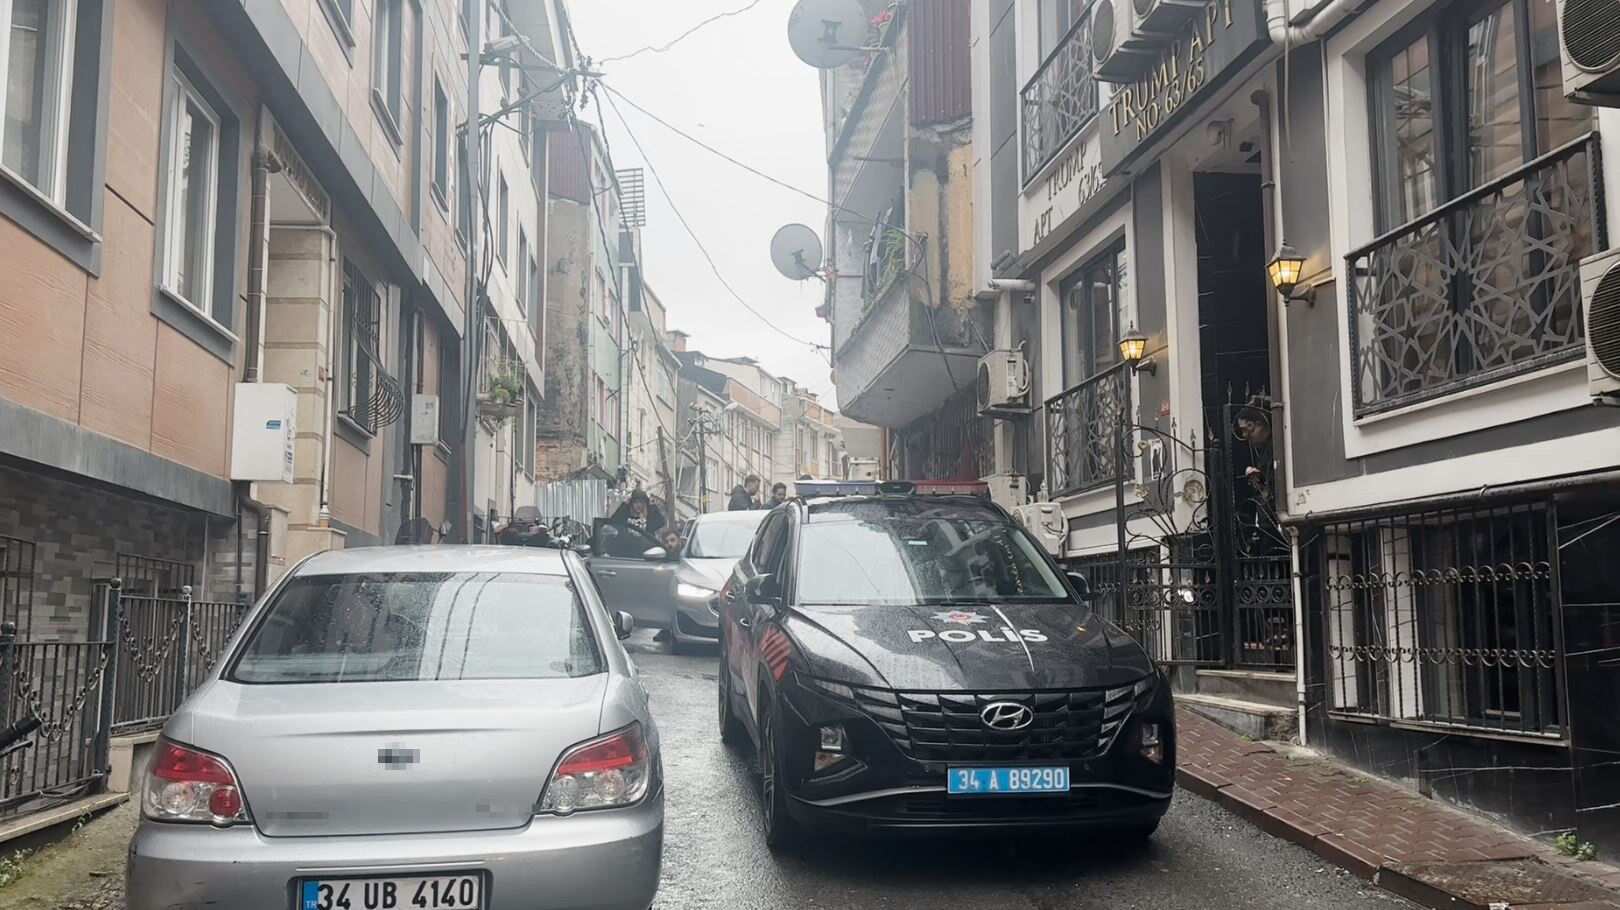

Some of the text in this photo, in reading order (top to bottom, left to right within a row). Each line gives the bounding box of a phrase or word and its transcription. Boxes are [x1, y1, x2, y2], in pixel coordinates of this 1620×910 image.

[1108, 40, 1181, 136] TRUMP
[1136, 54, 1205, 142] NO: 63/65
[1045, 142, 1088, 201] TRUMP
[1033, 205, 1054, 245] APT
[958, 767, 1065, 790] 34 A 89290
[305, 900, 317, 909] TR
[317, 878, 475, 910] 34 UB 4140
